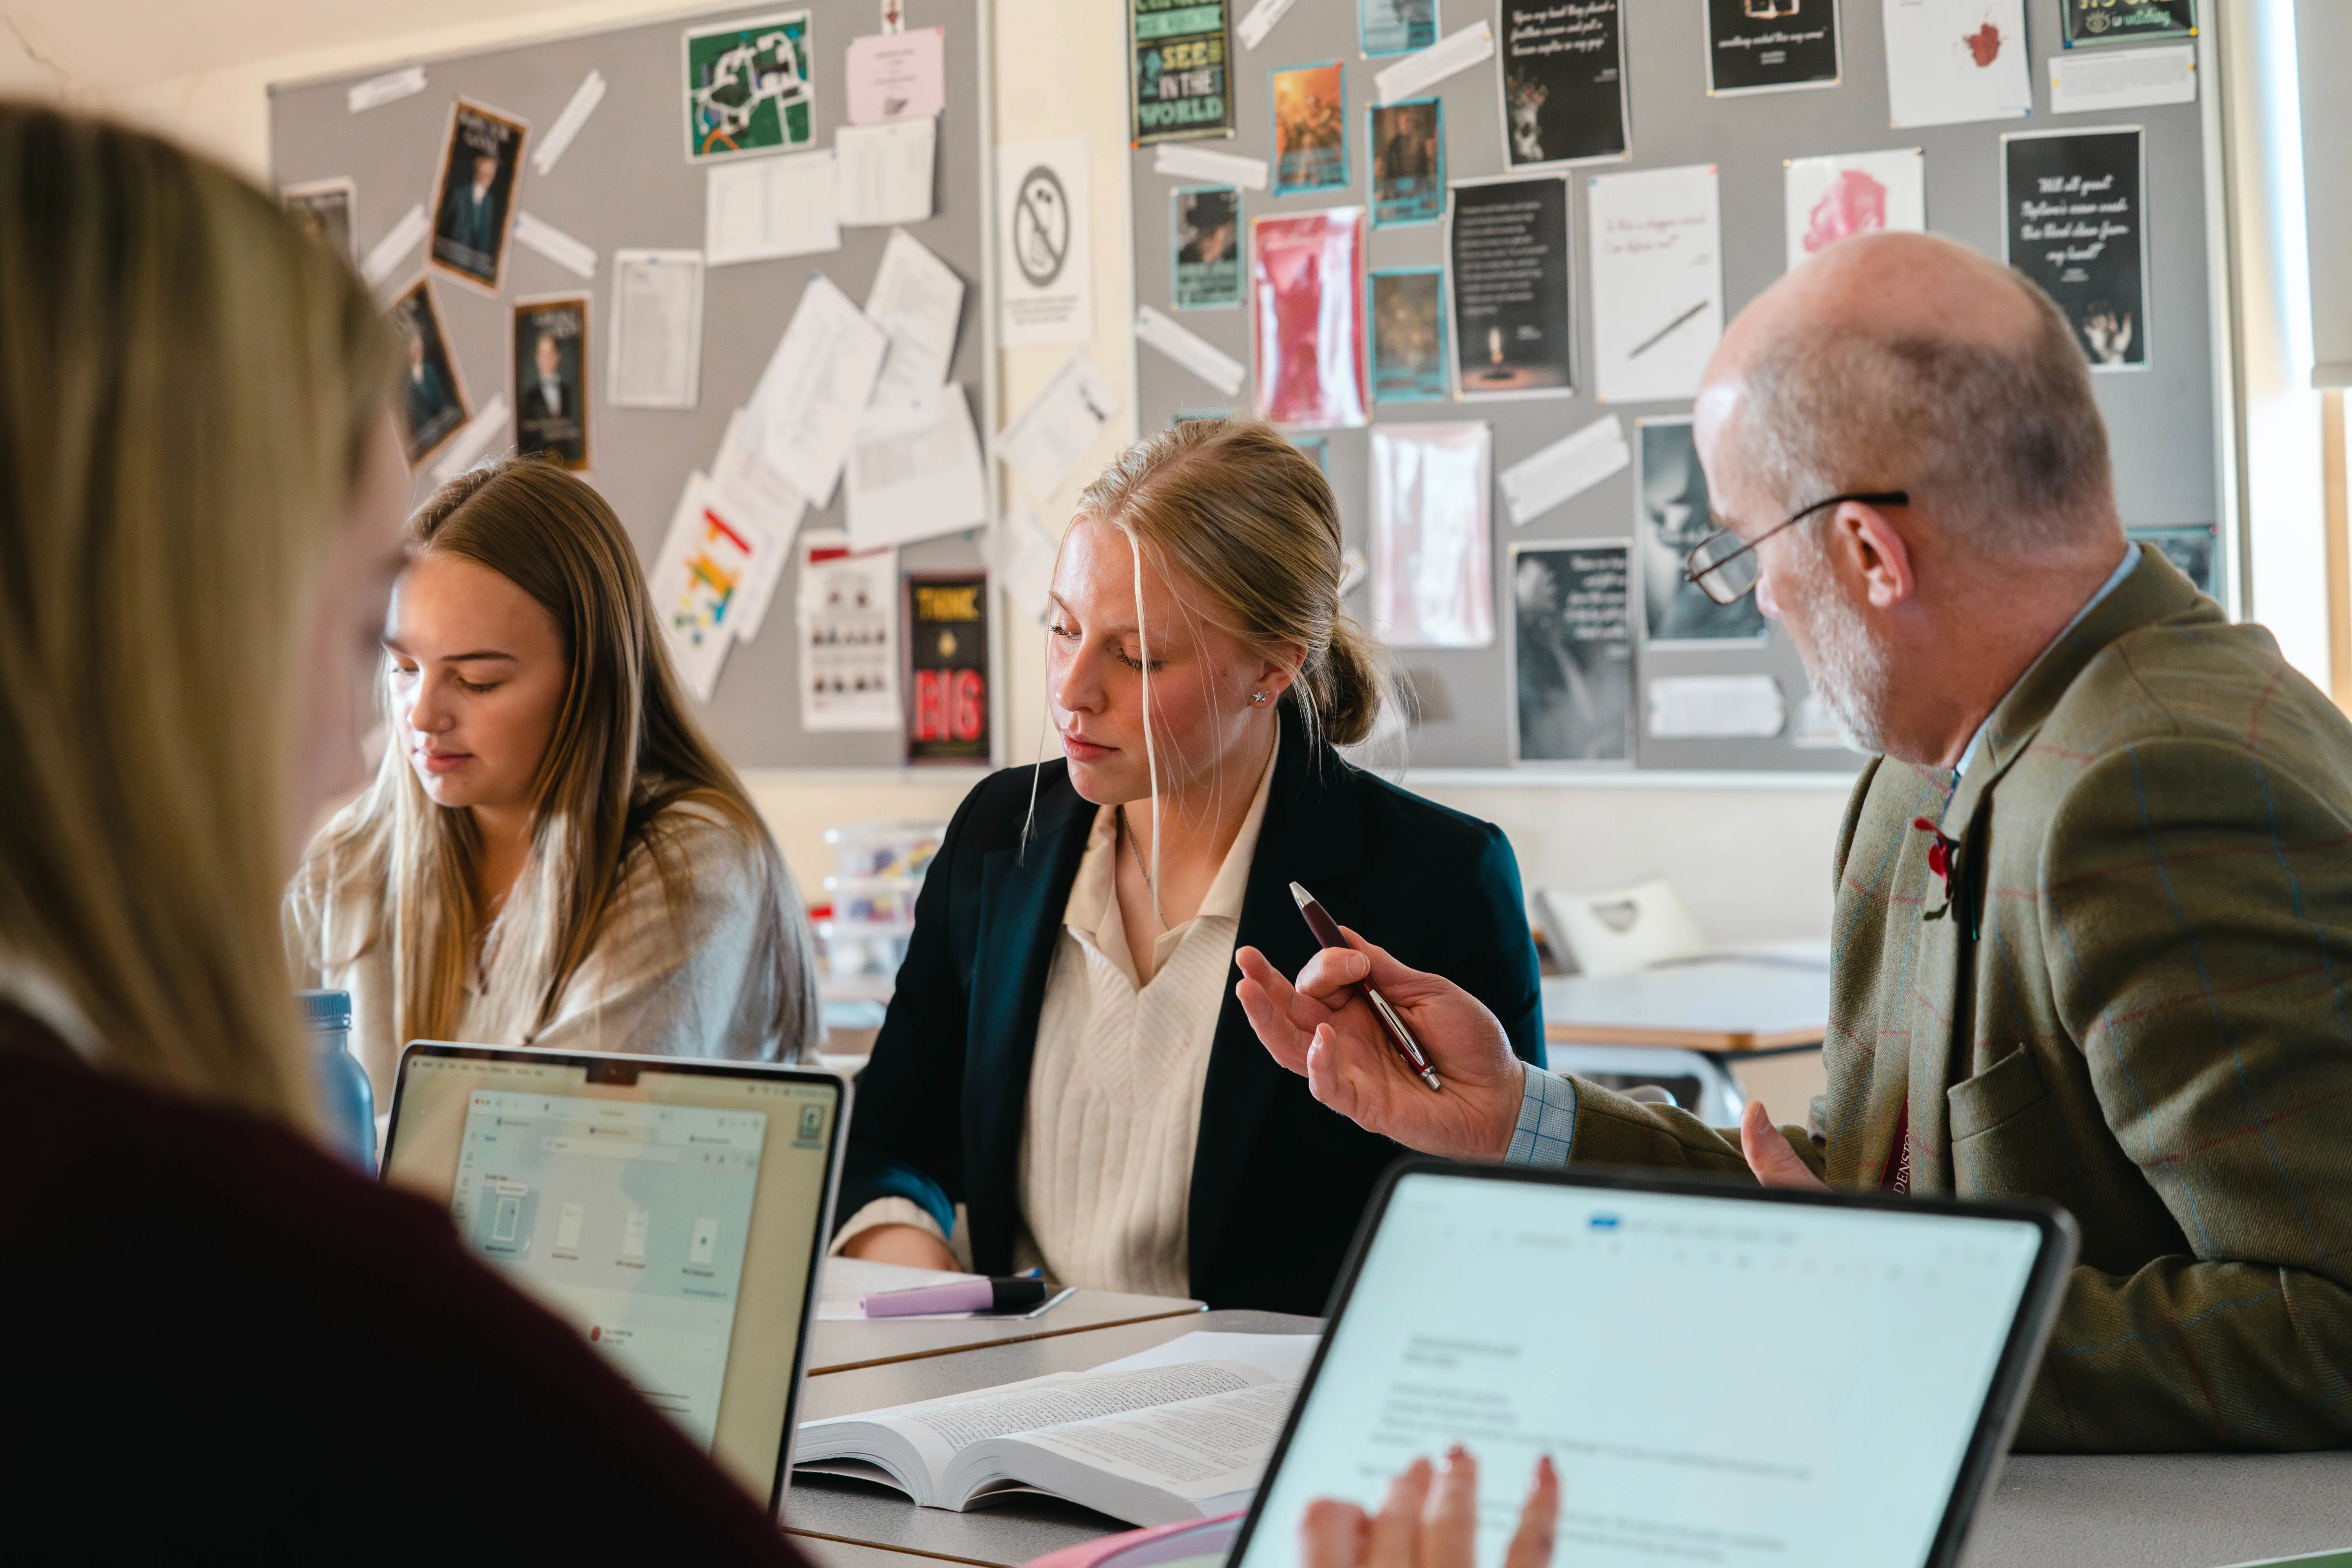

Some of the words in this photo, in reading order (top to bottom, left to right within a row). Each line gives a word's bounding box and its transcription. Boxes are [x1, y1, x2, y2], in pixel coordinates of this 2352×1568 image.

[1162, 42, 1208, 71] SEE
[1159, 76, 1179, 101] IN
[1180, 70, 1213, 98] THE
[1139, 96, 1223, 129] WORLD
[915, 668, 984, 741] BIG
